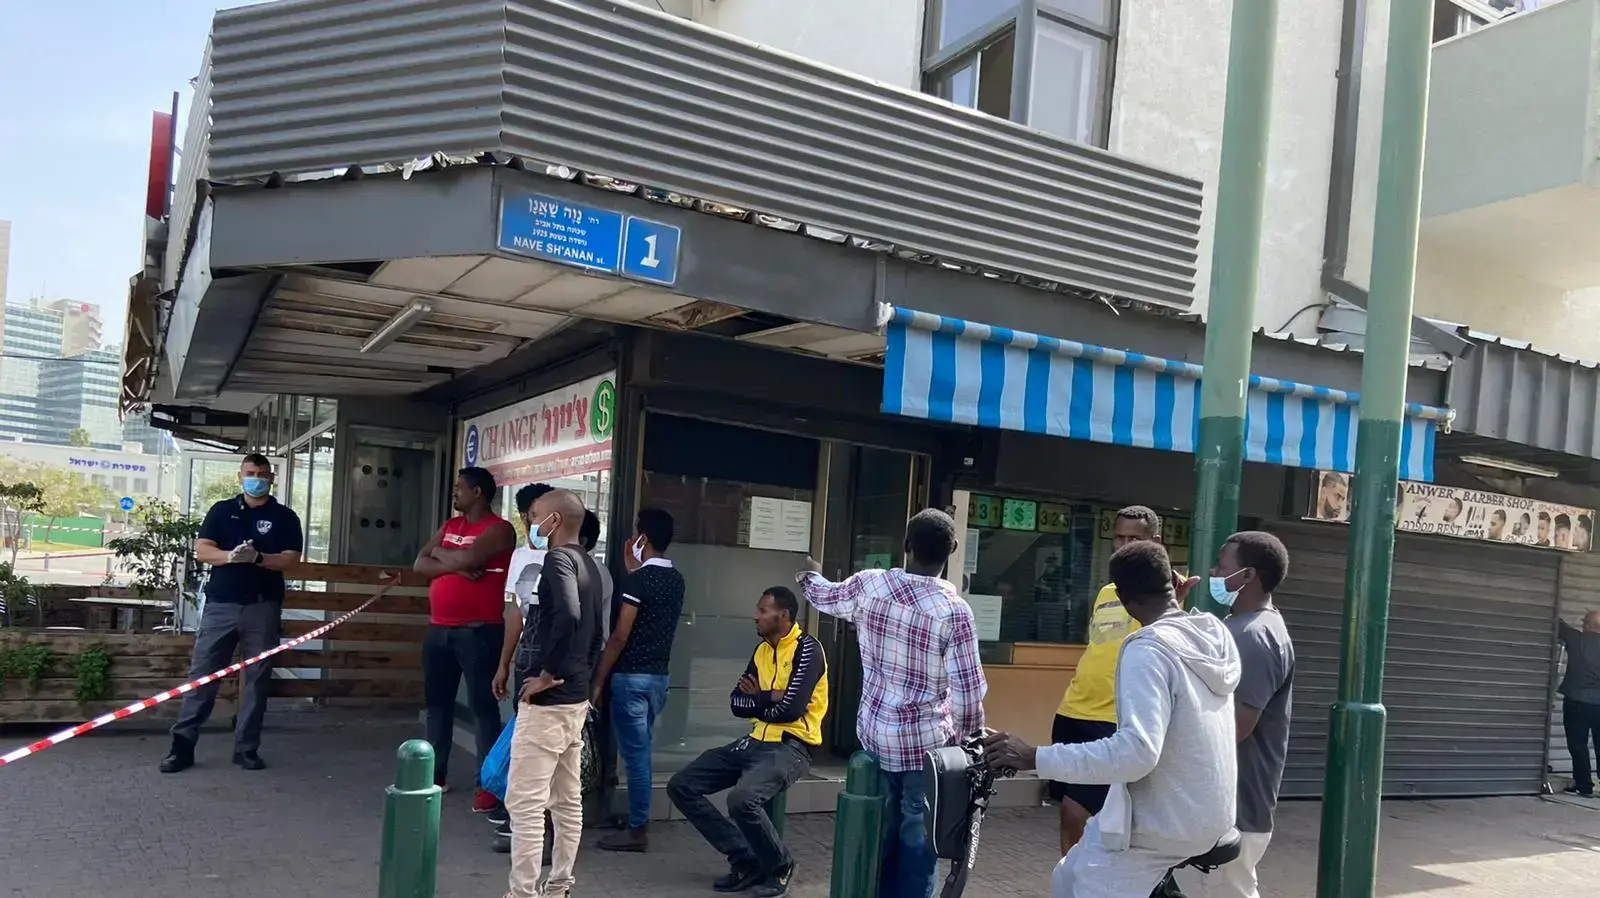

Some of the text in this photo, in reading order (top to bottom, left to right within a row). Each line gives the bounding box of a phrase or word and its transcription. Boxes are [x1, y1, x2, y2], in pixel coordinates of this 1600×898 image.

[513, 236, 544, 252] NAVE
[546, 242, 594, 262] SH'ANAN
[640, 234, 661, 268] 1
[481, 412, 539, 461] CHANGE
[68, 457, 146, 473] משטרת ישראל
[1462, 491, 1505, 507] BARBER
[1402, 520, 1435, 533] מספרה
[1437, 523, 1463, 537] BEST
